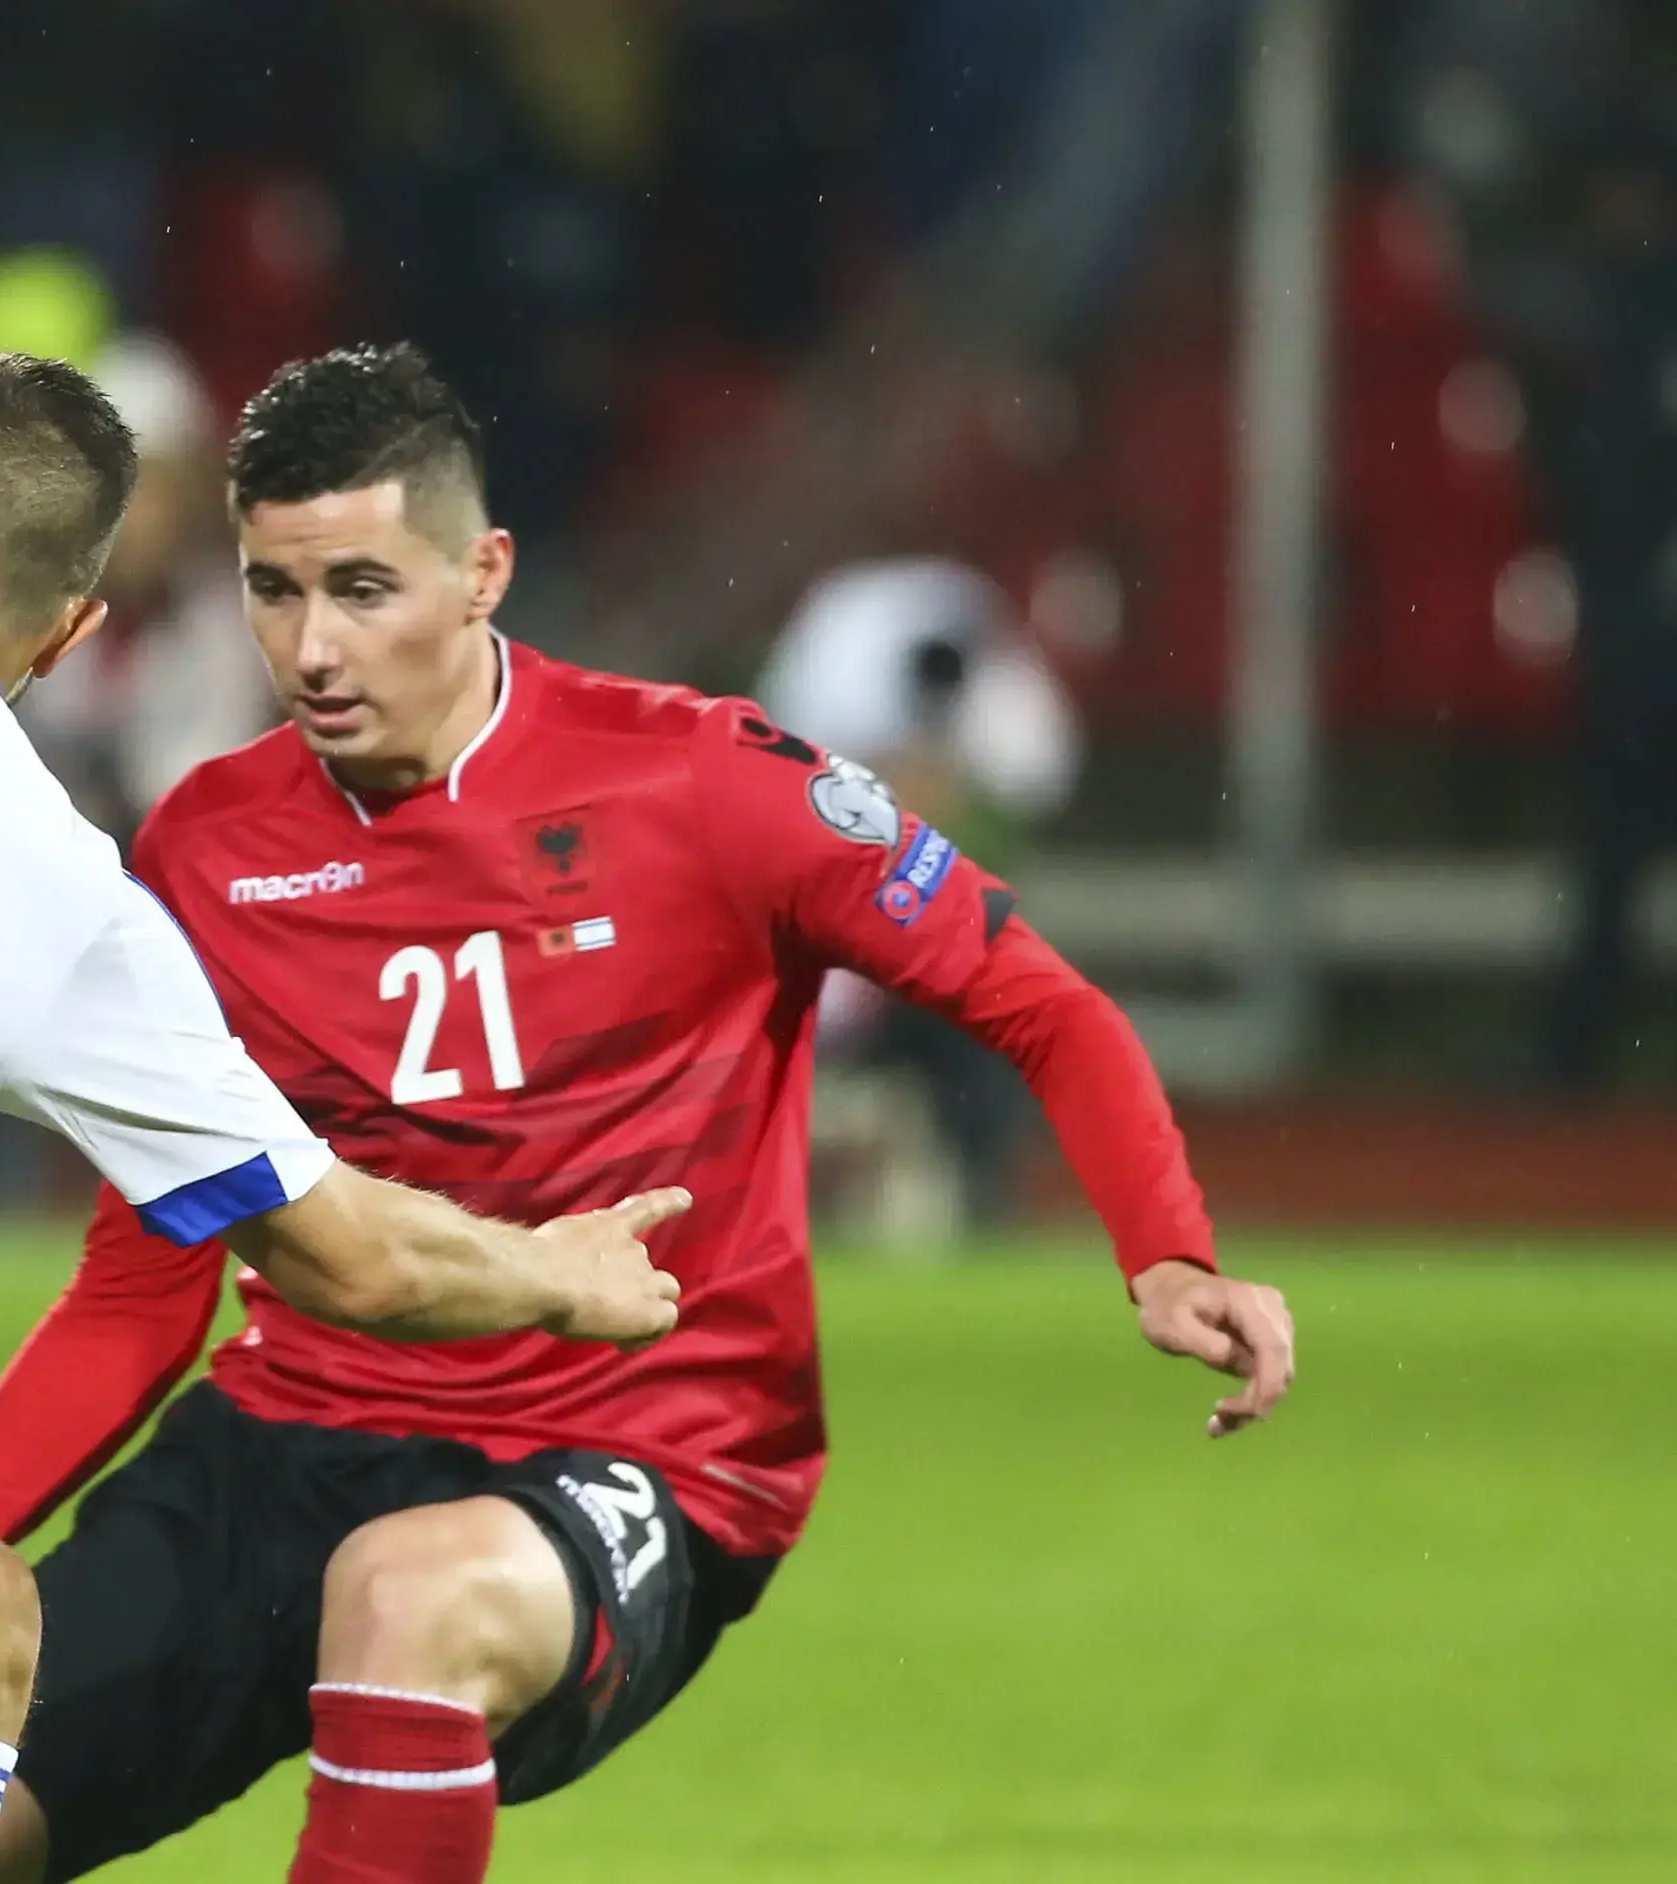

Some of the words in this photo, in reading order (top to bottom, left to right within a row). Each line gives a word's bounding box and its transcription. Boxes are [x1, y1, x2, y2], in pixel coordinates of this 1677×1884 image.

[229, 860, 365, 904] macron
[378, 930, 525, 1105] 21
[581, 1461, 668, 1590] 21
